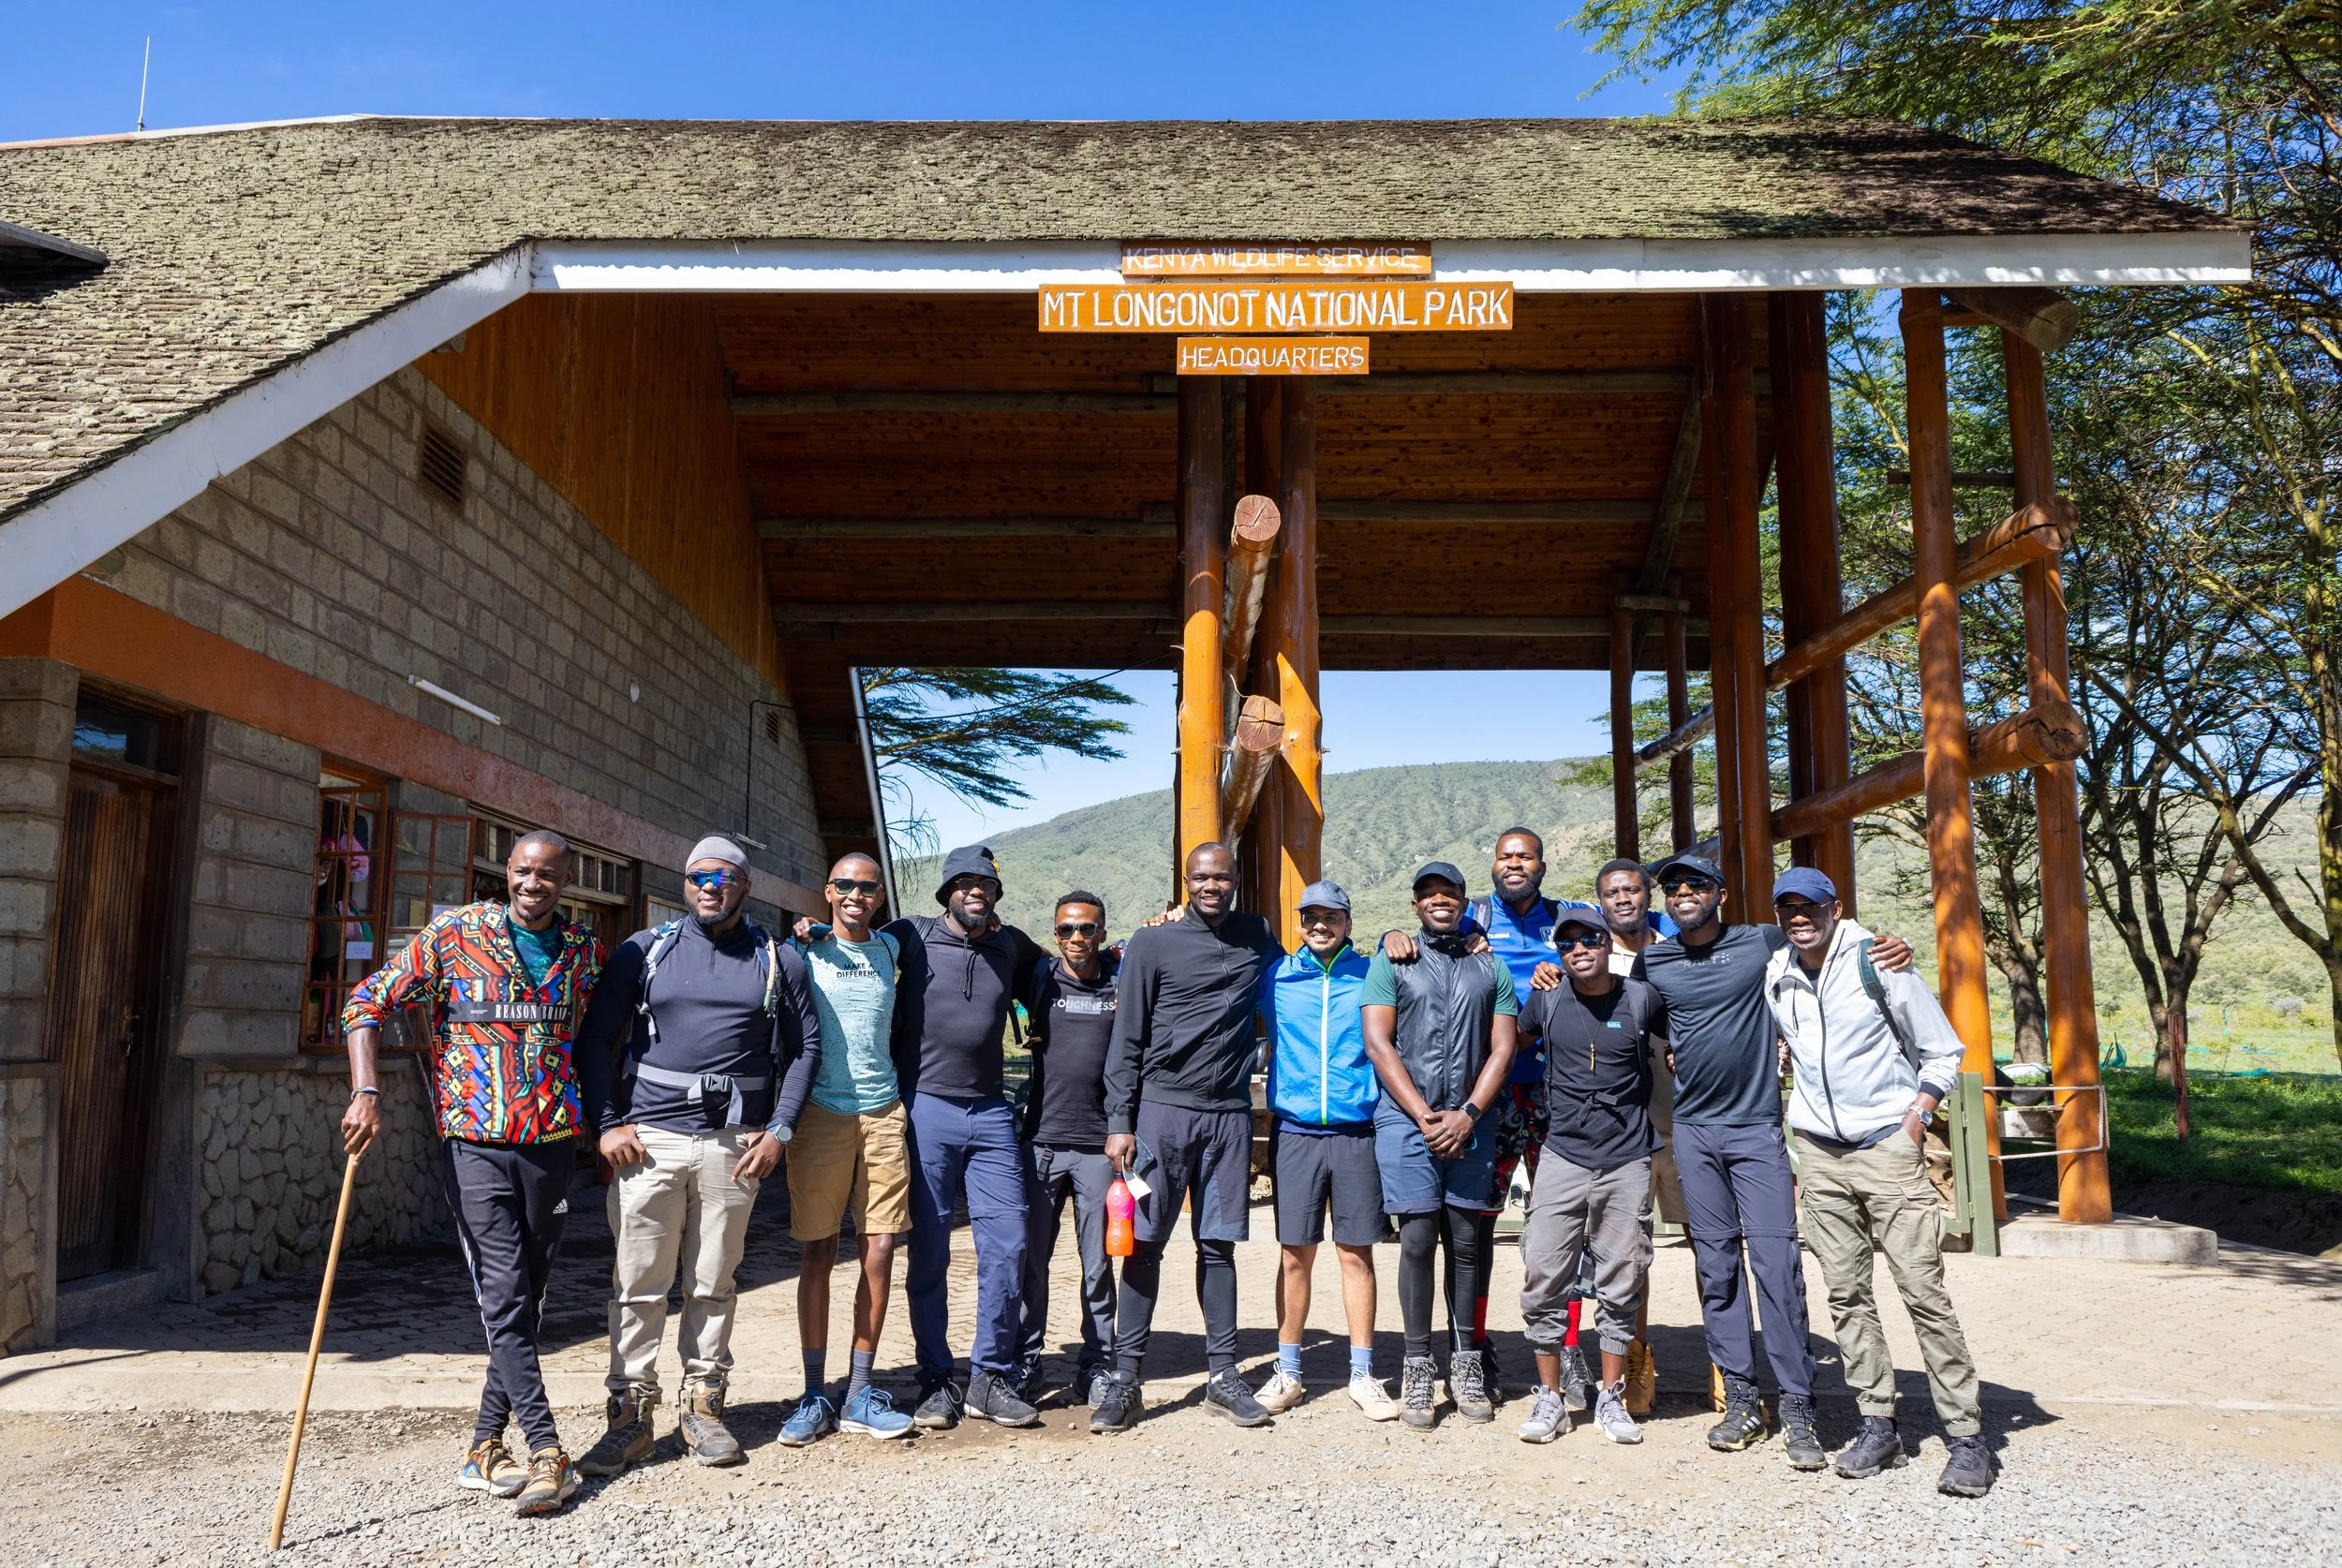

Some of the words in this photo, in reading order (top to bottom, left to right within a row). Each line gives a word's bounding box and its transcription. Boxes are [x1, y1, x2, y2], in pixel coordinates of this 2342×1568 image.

[1126, 246, 1206, 270] KENYA
[1212, 246, 1311, 268] WILDLIFE
[1315, 246, 1418, 268] SERVICE
[1044, 289, 1085, 327] MT
[1093, 289, 1260, 327] LONGONOT
[1265, 288, 1418, 327] NATIONAL
[1423, 288, 1509, 326] PARK
[1181, 346, 1365, 368] HEADQUARTERS
[843, 962, 867, 970] MAKE
[836, 969, 882, 979] DIFFERENCE
[495, 1004, 538, 1019] REASON
[1051, 998, 1115, 1012] TOUGHNESS
